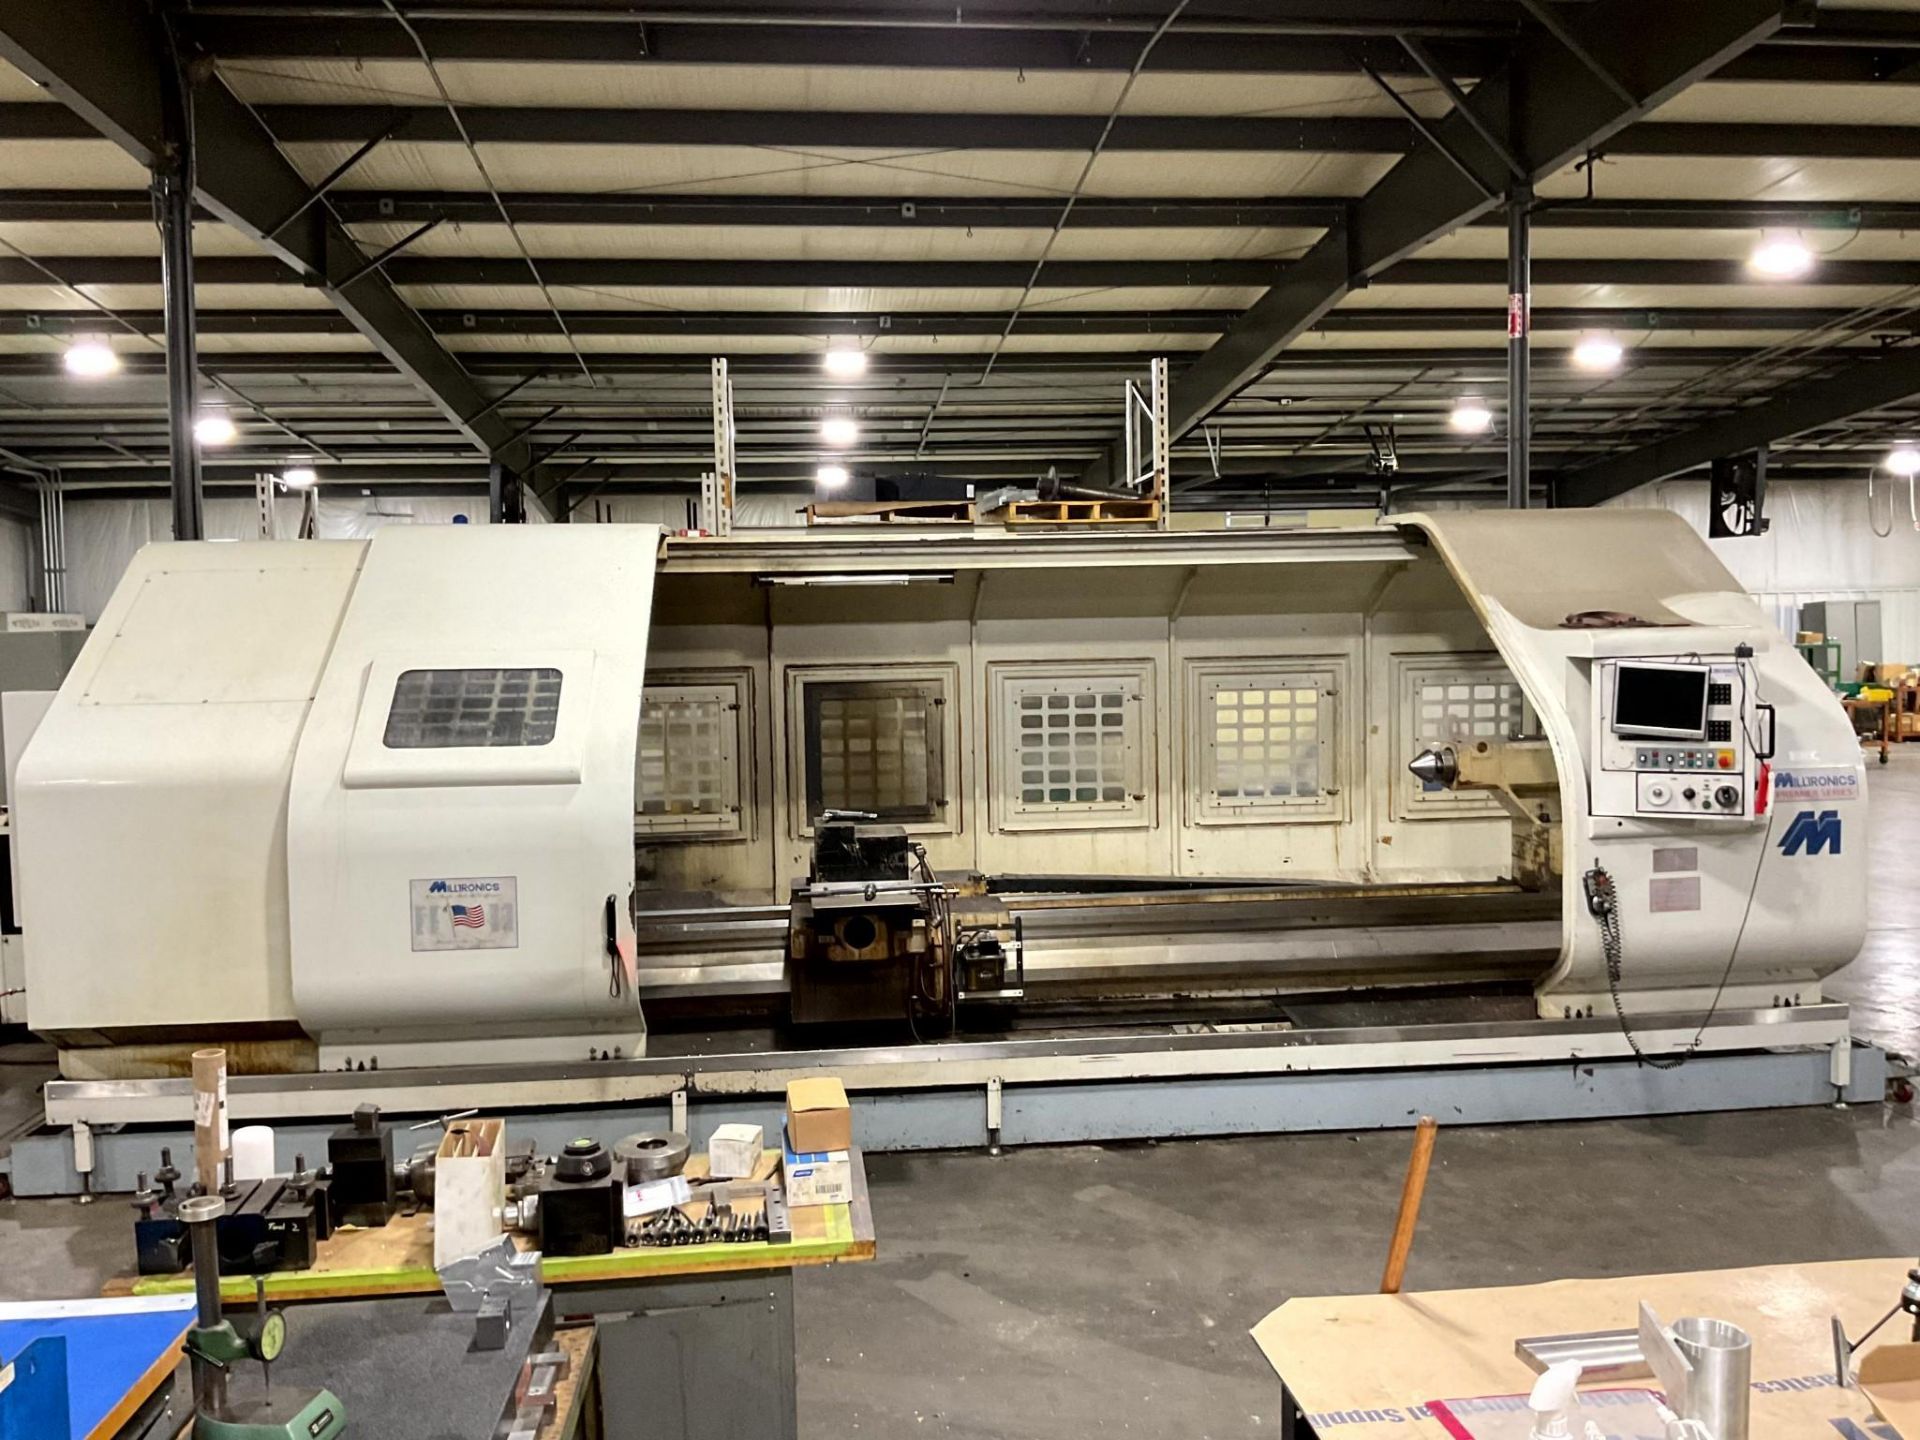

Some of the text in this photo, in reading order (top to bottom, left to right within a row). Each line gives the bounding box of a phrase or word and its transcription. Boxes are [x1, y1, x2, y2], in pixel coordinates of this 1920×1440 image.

[1775, 772, 1856, 788] MILLTRONICS
[428, 880, 500, 893] MILLTRONICS
[291, 1222, 300, 1232] 2
